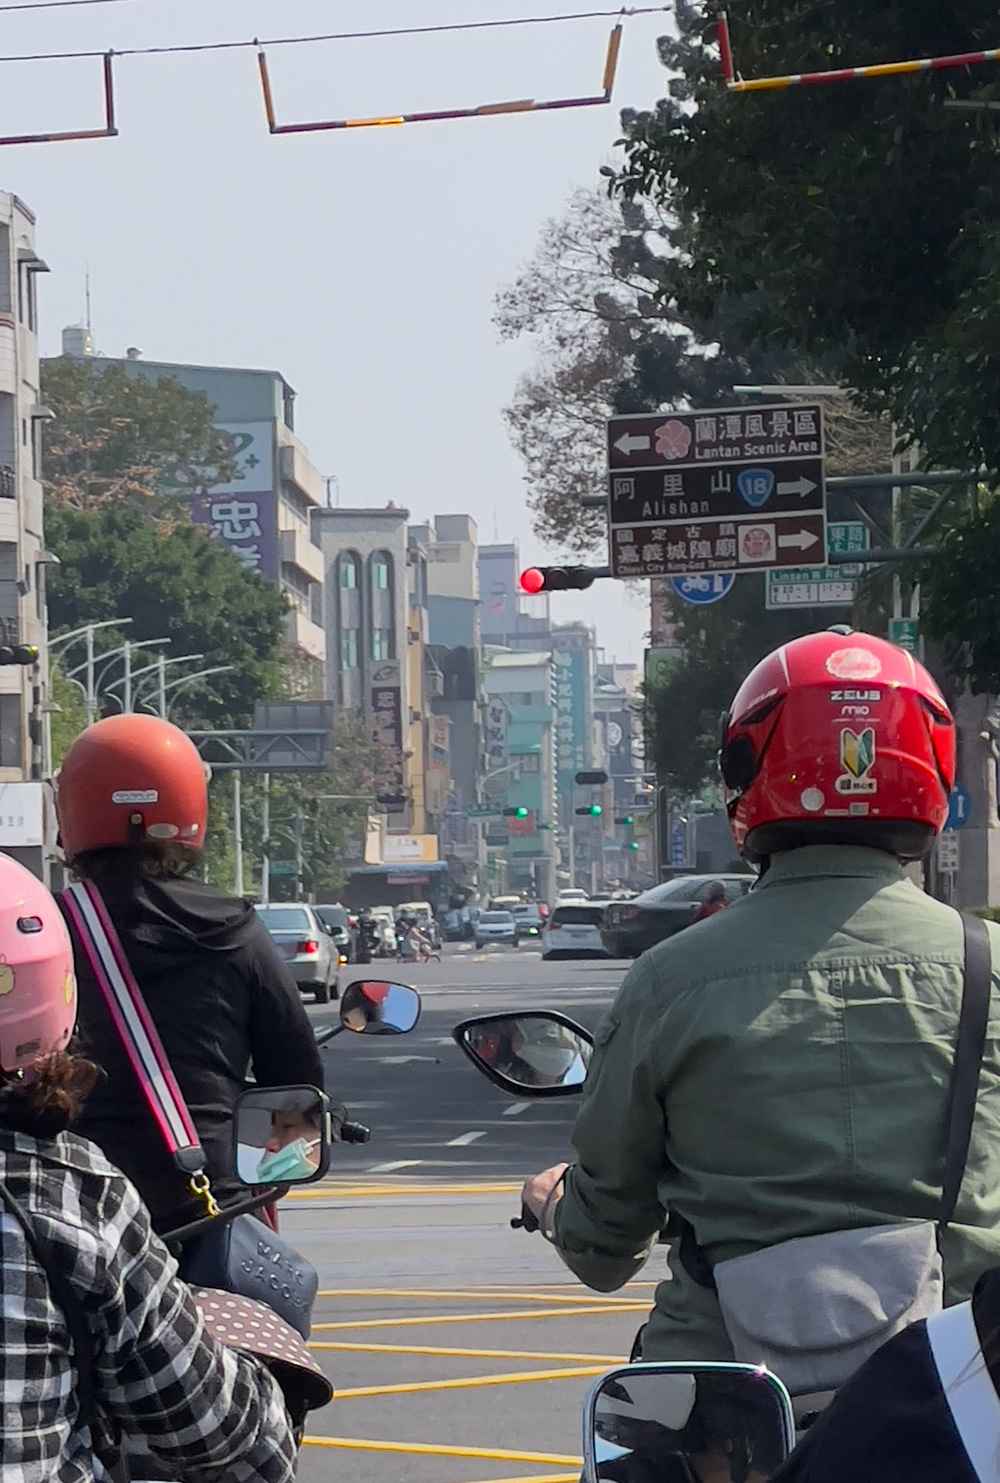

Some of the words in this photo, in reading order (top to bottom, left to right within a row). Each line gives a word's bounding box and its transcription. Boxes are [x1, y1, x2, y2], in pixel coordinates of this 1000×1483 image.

[695, 410, 817, 443] 蘭潭風景區
[695, 446, 740, 459] Lantan
[744, 442, 785, 456] Scenic
[788, 440, 818, 453] Area
[613, 470, 731, 501] 阿里山
[746, 477, 767, 495] 18
[642, 500, 710, 517] Alishan
[618, 537, 737, 564] 嘉義城隍廟
[771, 570, 810, 582] Linsen
[830, 690, 881, 701] ZEUS
